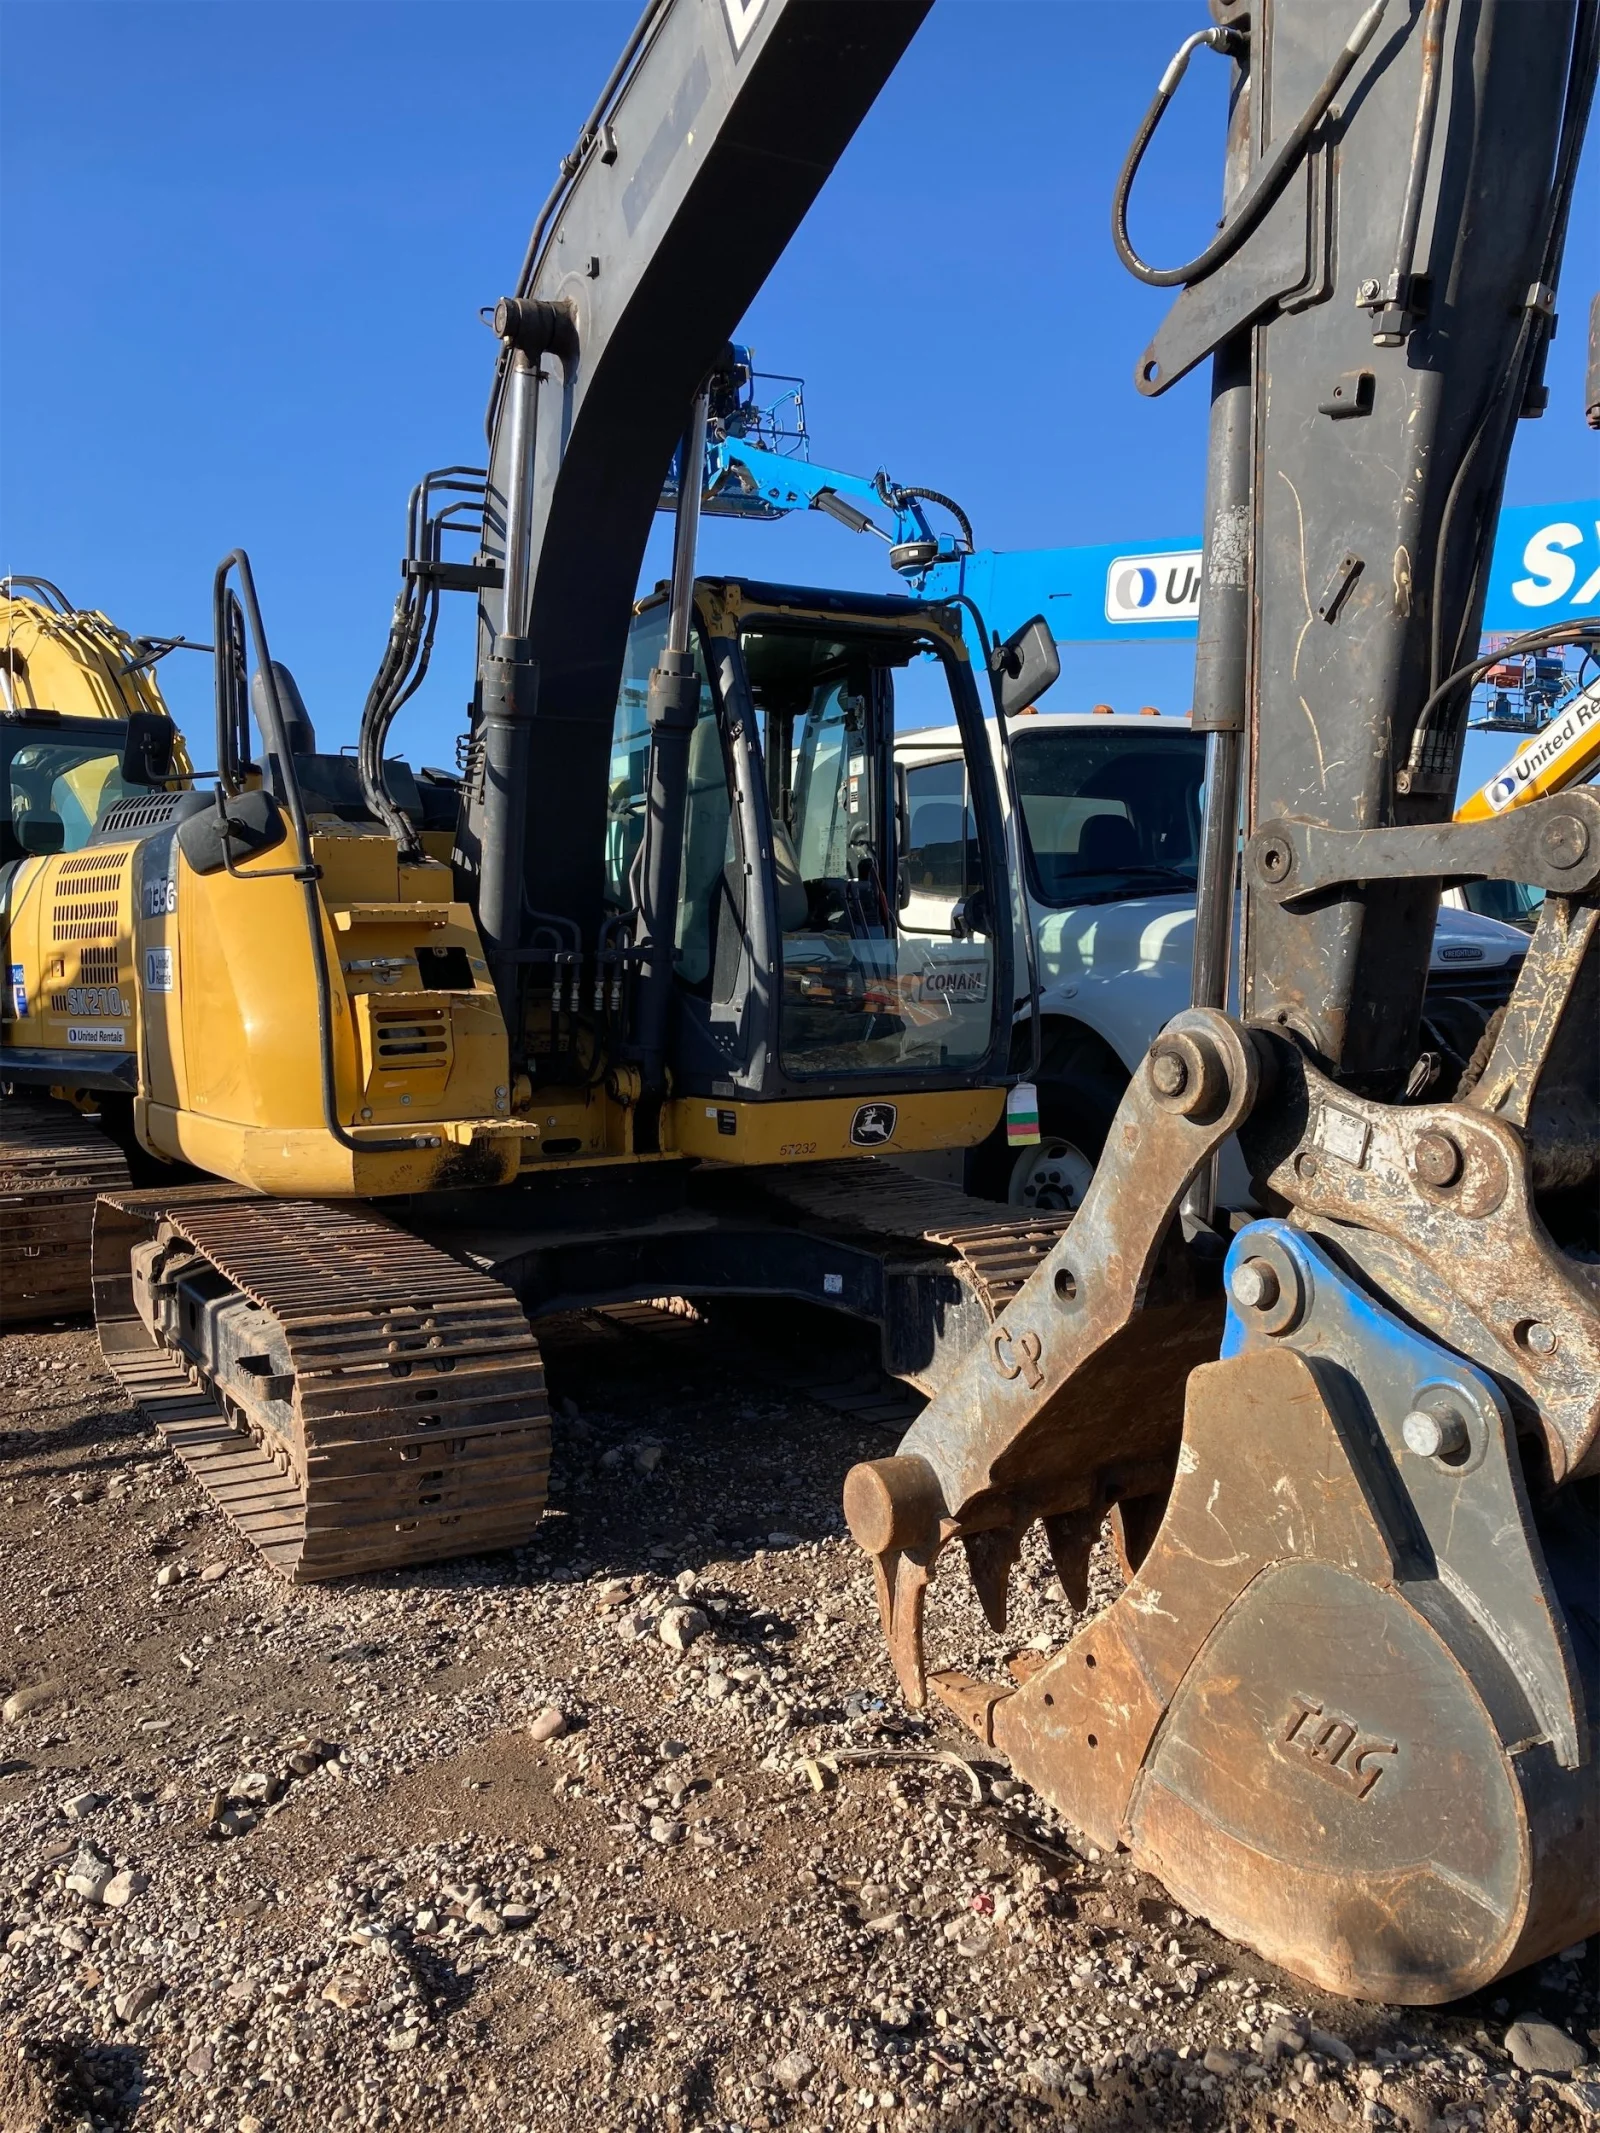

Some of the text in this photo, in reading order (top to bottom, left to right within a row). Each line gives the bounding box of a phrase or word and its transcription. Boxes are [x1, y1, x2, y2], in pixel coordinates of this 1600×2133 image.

[1515, 720, 1575, 782] United
[150, 880, 178, 914] 135G
[156, 954, 169, 970] United
[156, 971, 172, 986] Rentals
[926, 972, 982, 991] CONAM
[77, 1030, 122, 1042] United Rentals
[779, 1142, 817, 1156] 57232
